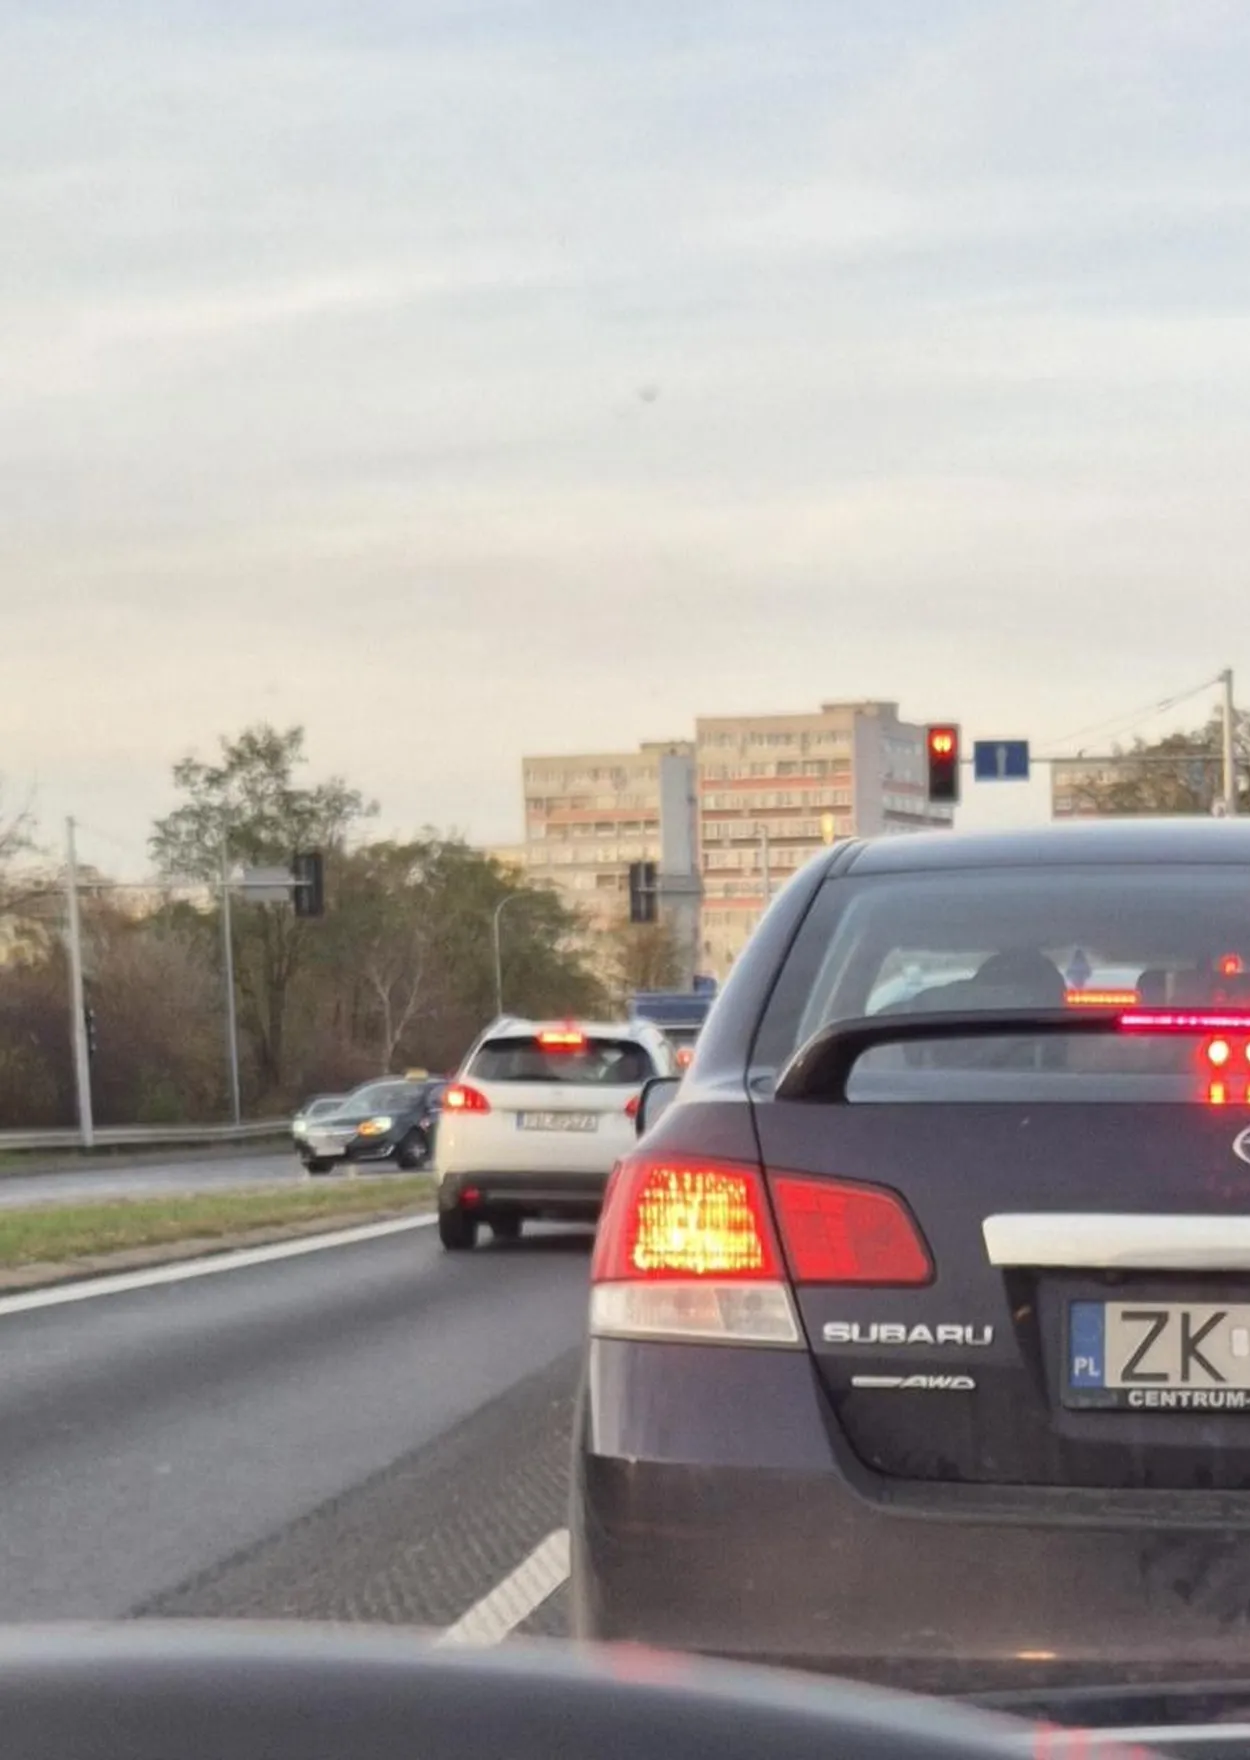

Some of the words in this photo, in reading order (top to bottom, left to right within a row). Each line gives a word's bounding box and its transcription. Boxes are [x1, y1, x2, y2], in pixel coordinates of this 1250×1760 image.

[823, 1321, 993, 1345] SUBARU
[1120, 1311, 1227, 1382] ZK
[1074, 1357, 1100, 1377] PL
[900, 1375, 976, 1390] AWD
